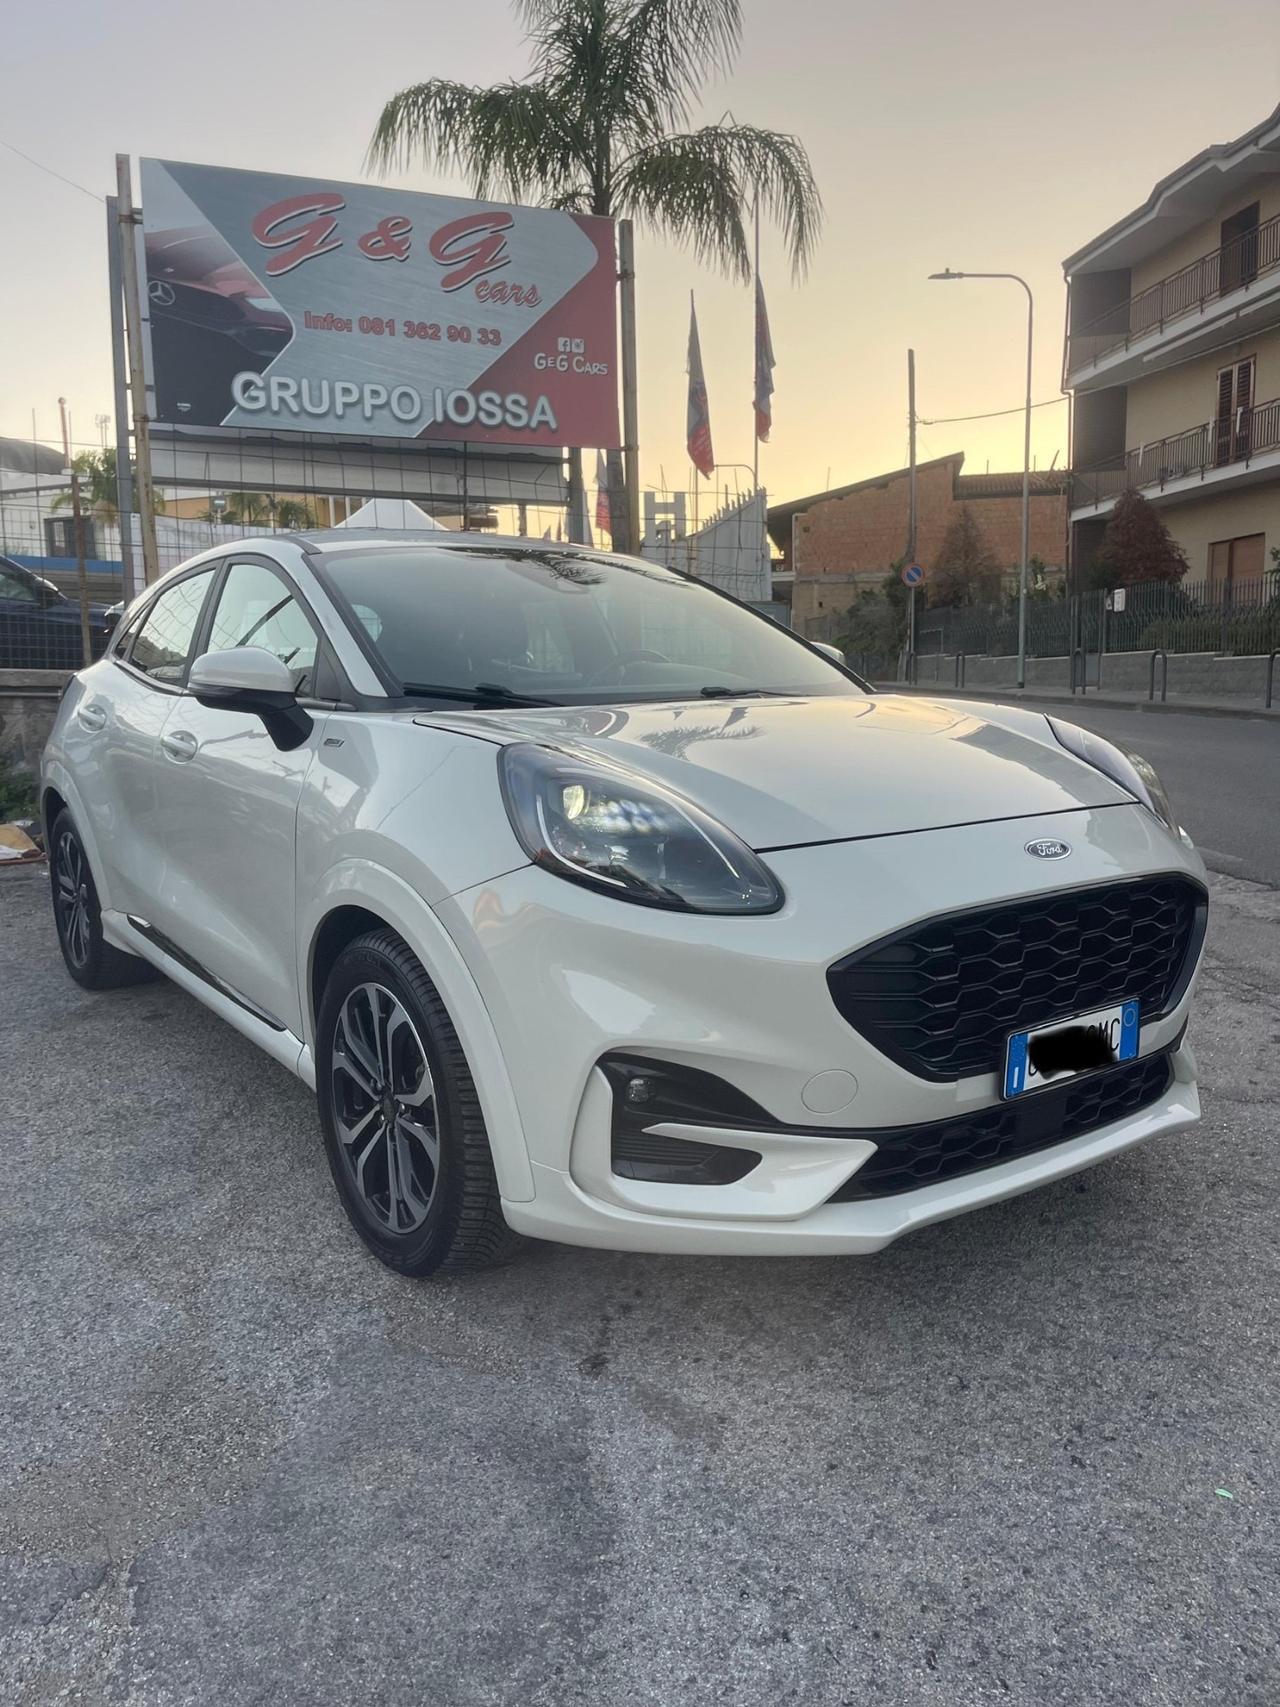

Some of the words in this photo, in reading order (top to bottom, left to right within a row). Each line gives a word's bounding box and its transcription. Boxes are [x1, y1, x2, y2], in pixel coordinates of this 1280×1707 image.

[252, 192, 345, 277] G
[357, 215, 413, 262] &
[428, 211, 515, 293] G
[474, 279, 542, 307] cars
[303, 310, 353, 334] Info:
[358, 315, 397, 337] 081
[447, 324, 473, 344] 90
[477, 327, 503, 347] 33
[230, 370, 422, 422] GRUPPO
[432, 386, 558, 431] IOSSA
[1036, 842, 1063, 856] Ford
